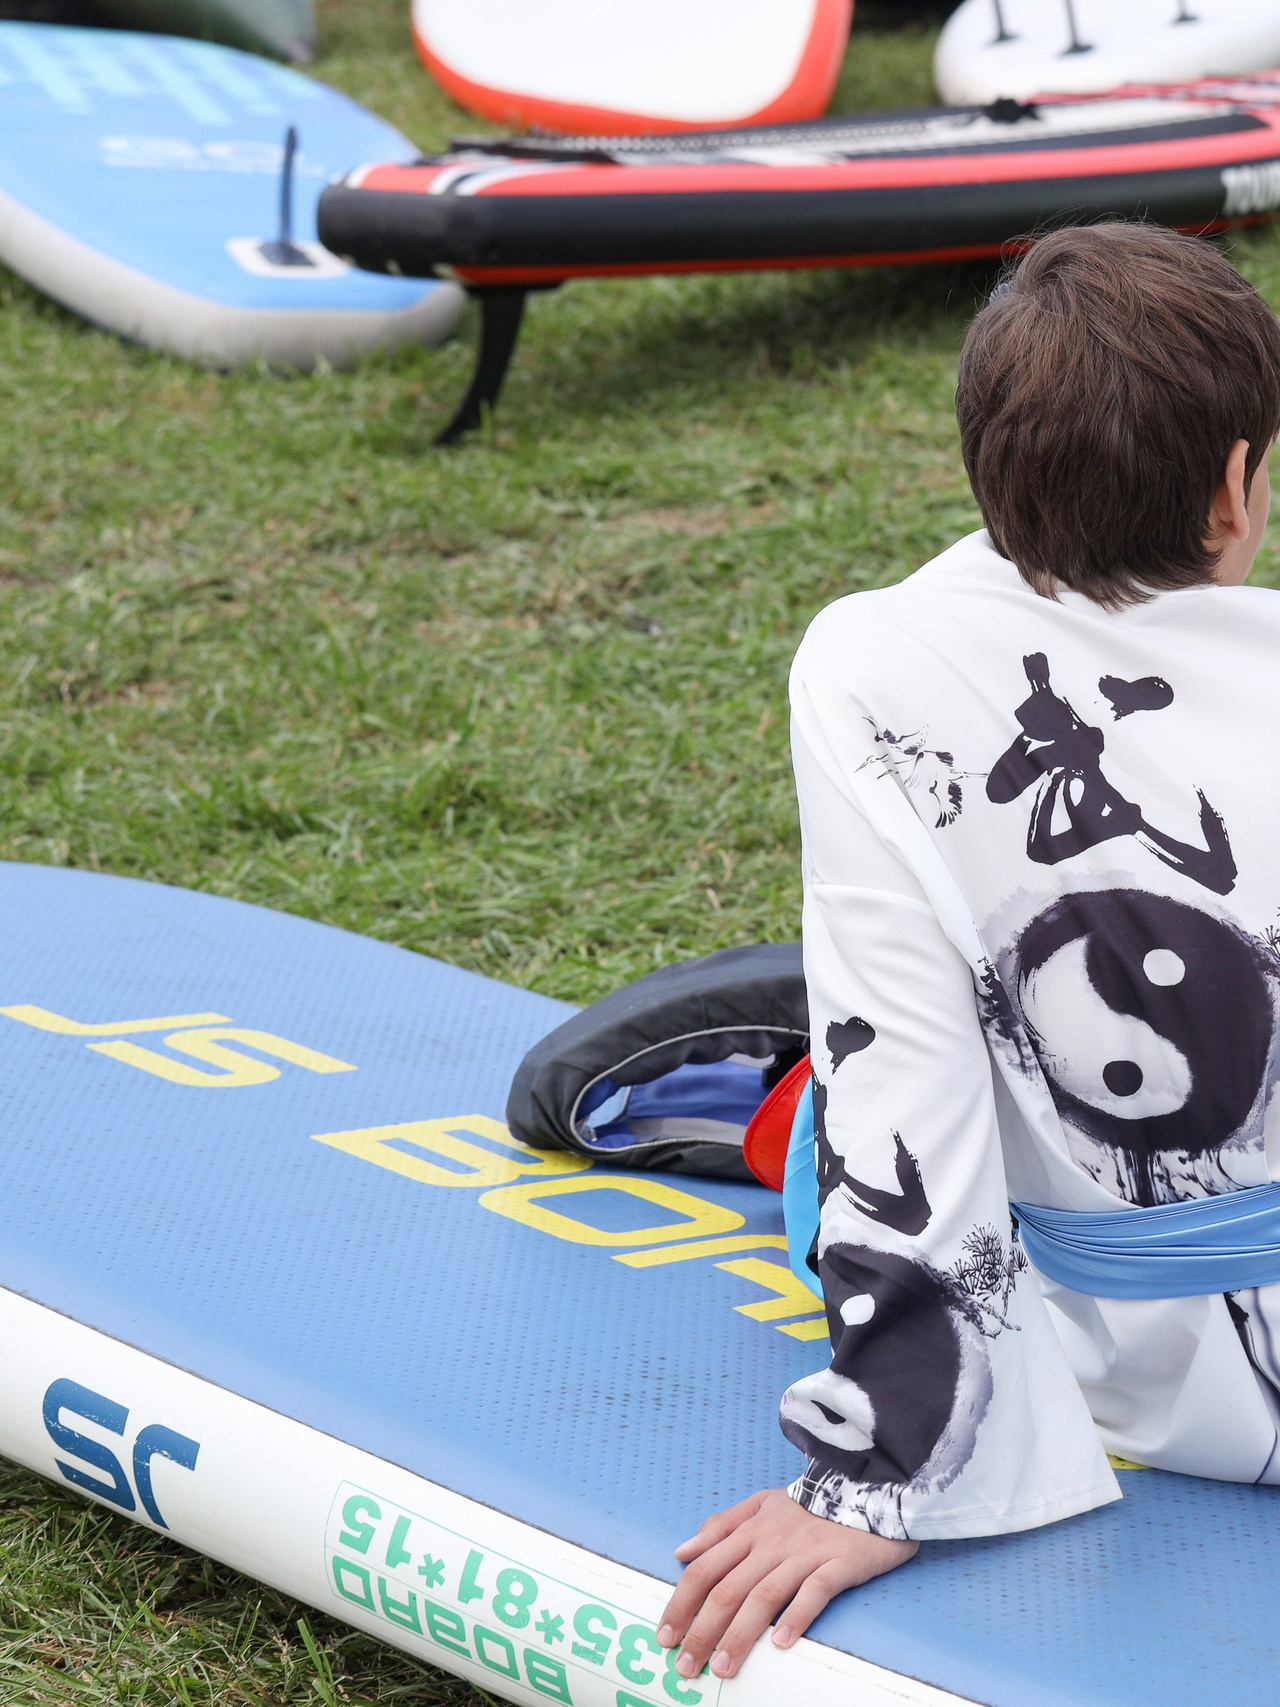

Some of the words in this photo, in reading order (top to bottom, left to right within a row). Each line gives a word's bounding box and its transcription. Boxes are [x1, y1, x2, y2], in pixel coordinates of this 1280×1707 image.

[0, 1004, 359, 1088] JS
[311, 1114, 829, 1341] BOA
[42, 1377, 201, 1530] JS
